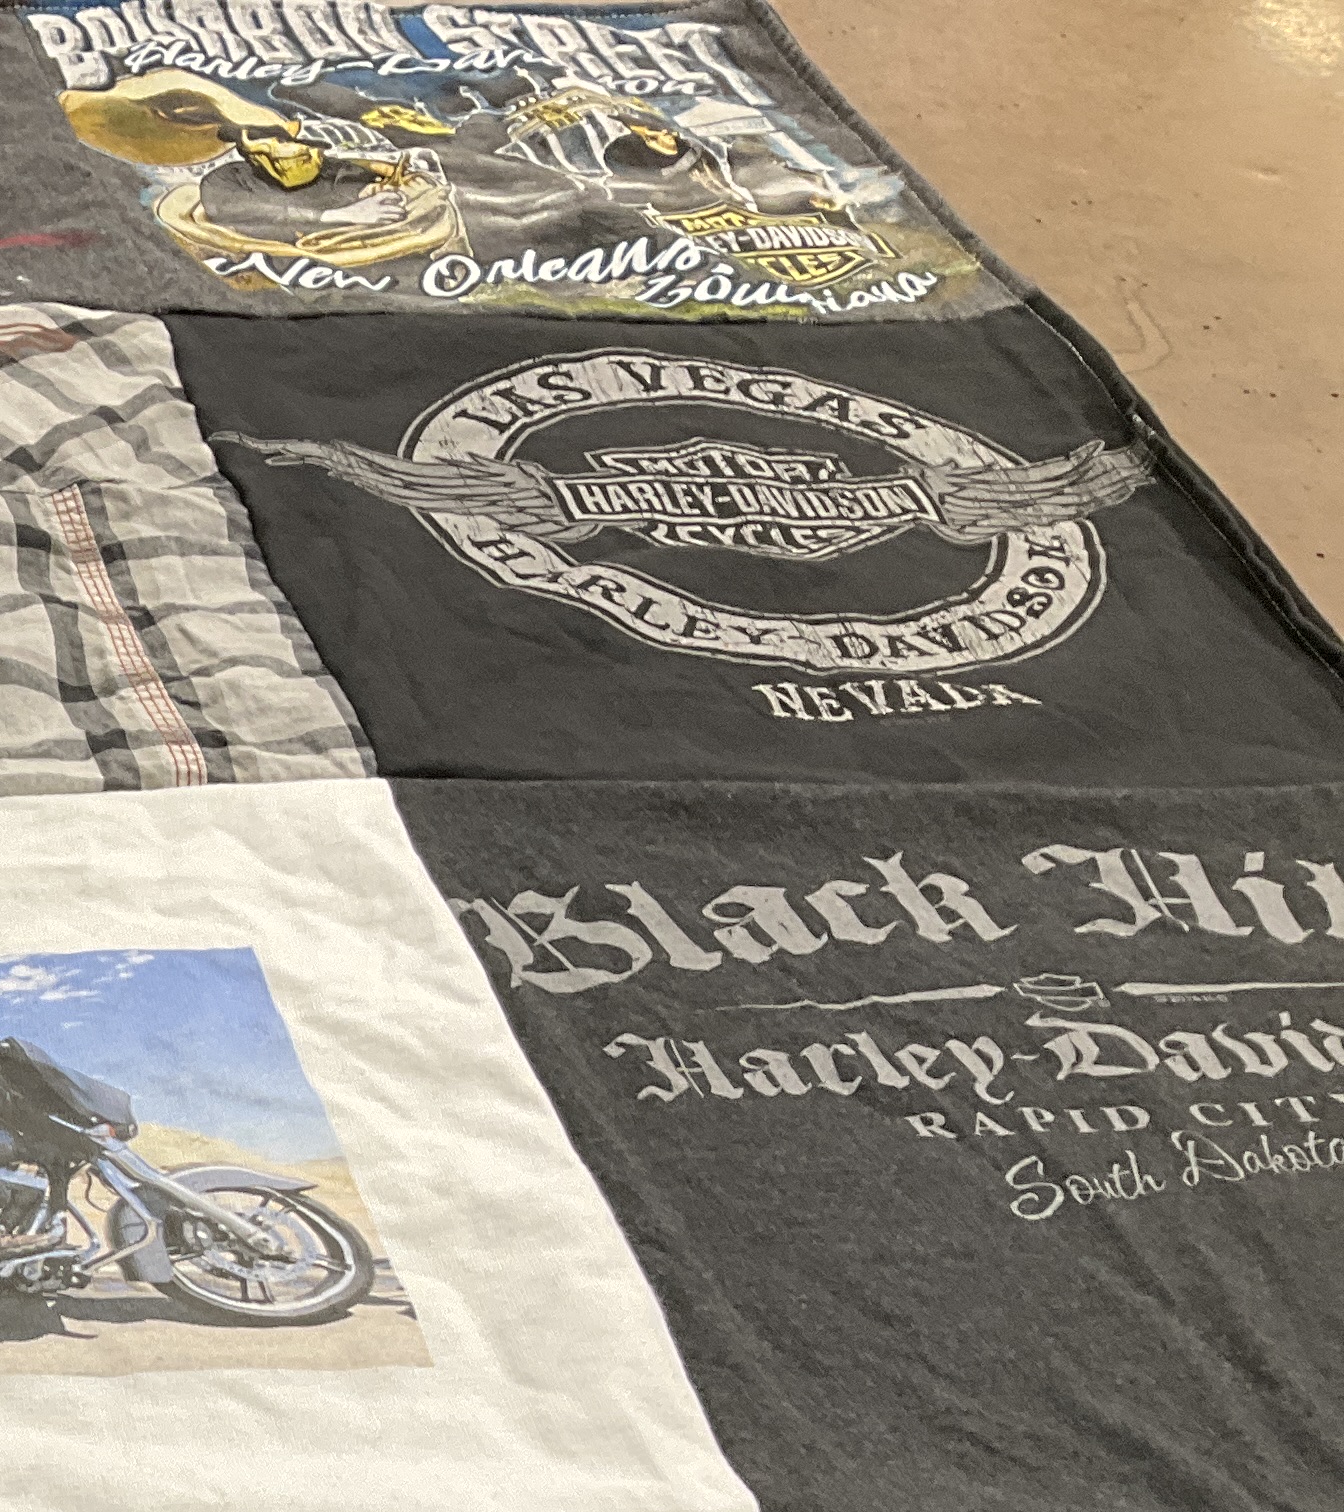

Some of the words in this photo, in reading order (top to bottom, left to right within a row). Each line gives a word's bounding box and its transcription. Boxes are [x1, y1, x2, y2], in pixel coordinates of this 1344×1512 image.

[421, 4, 775, 106] STREET
[204, 252, 391, 295] New
[452, 369, 591, 435] LAS
[606, 358, 929, 440] VEGAS
[637, 450, 811, 482] MOTOR
[574, 480, 921, 521] HARLEY-DAVIDSON
[450, 851, 1019, 995] Black
[904, 1105, 1152, 1140] RAPID
[1188, 1096, 1344, 1128] CIT
[1004, 1149, 1169, 1222] South
